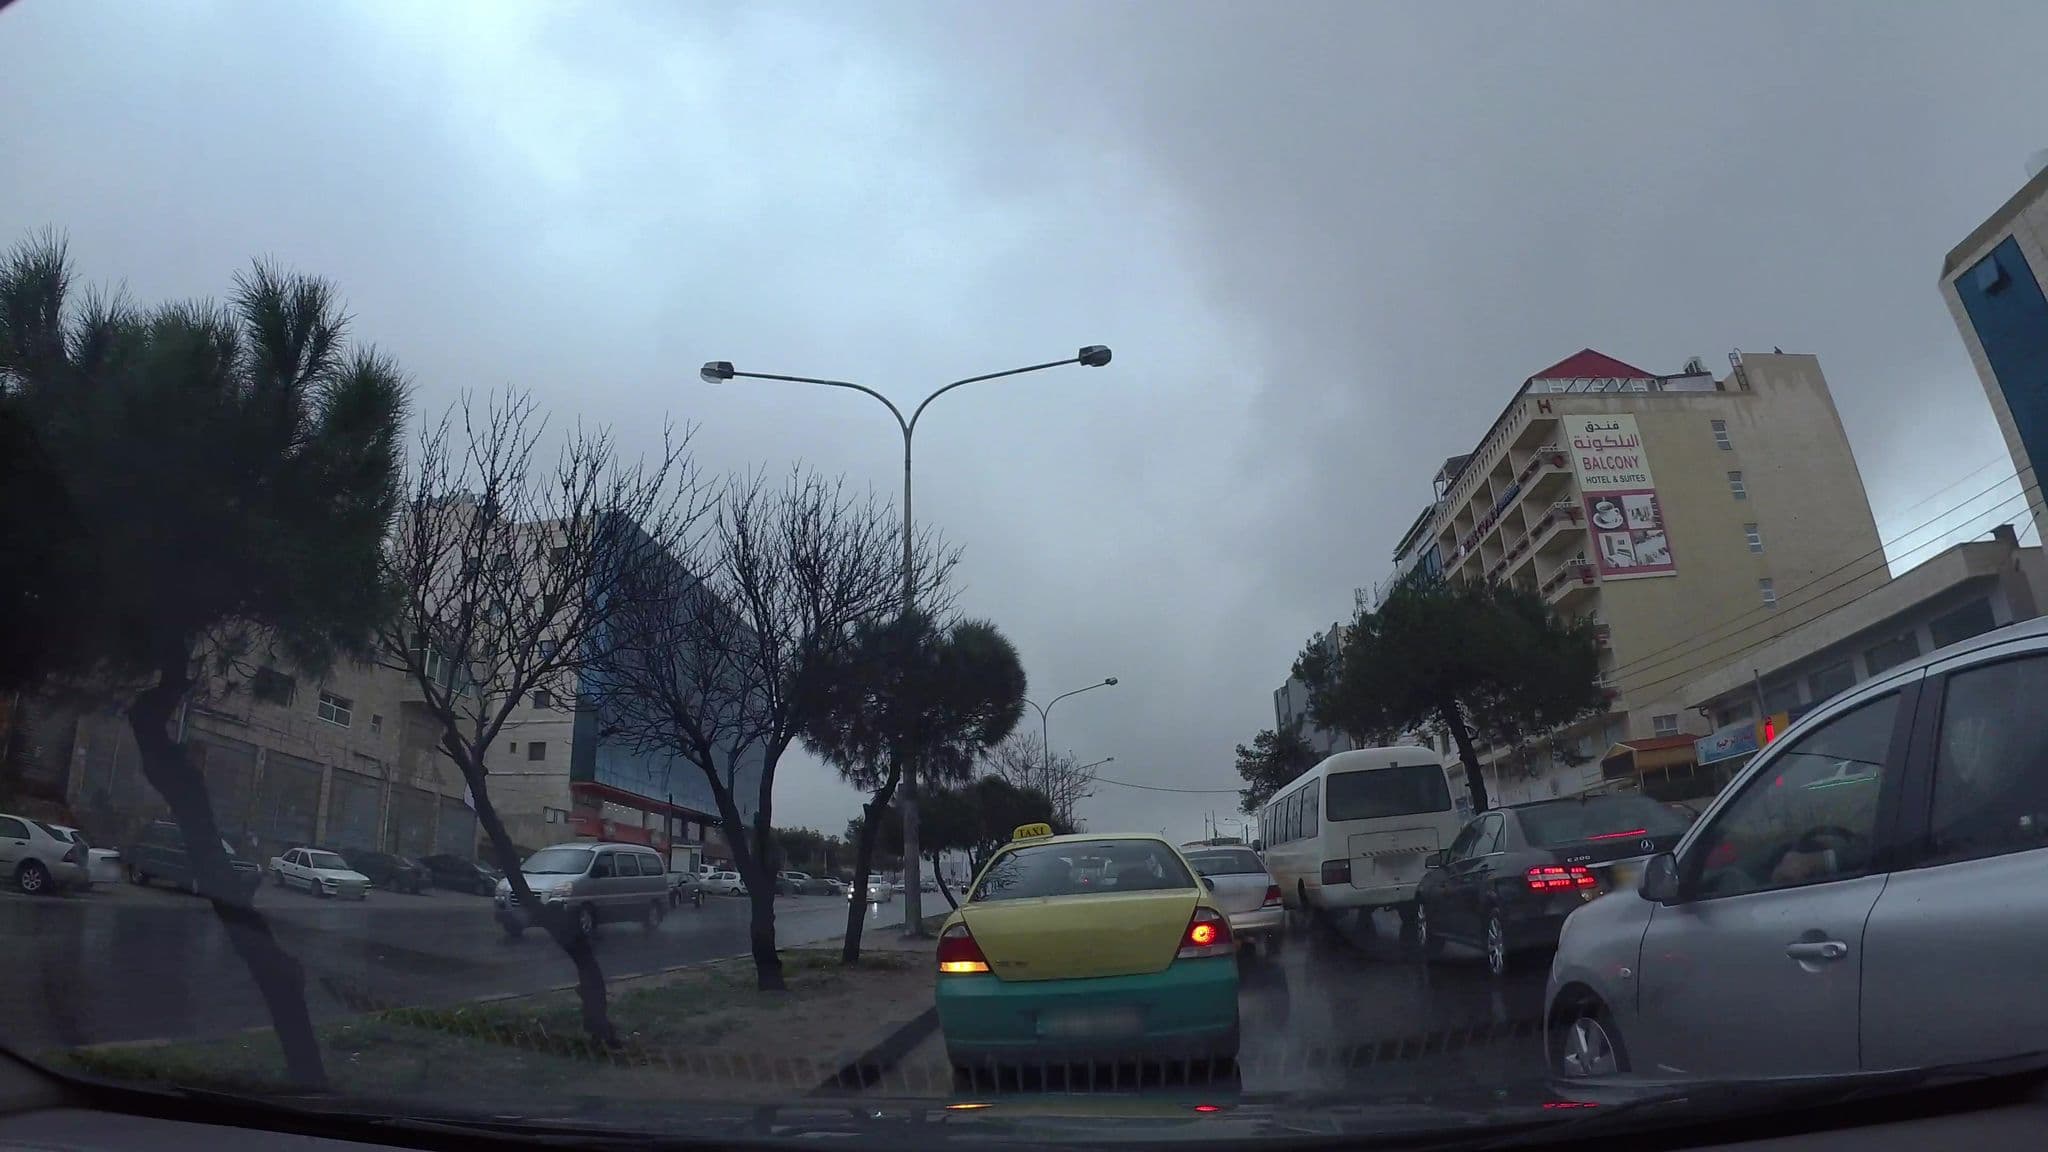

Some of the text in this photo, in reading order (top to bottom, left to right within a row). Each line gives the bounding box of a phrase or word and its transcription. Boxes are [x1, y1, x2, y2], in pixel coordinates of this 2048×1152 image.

[1585, 420, 1620, 433] فندق
[1573, 433, 1640, 452] البلكونة
[1582, 456, 1640, 471] BALCONY
[1585, 473, 1647, 485] HOTEL & SUITES
[1017, 826, 1044, 838] TAXI
